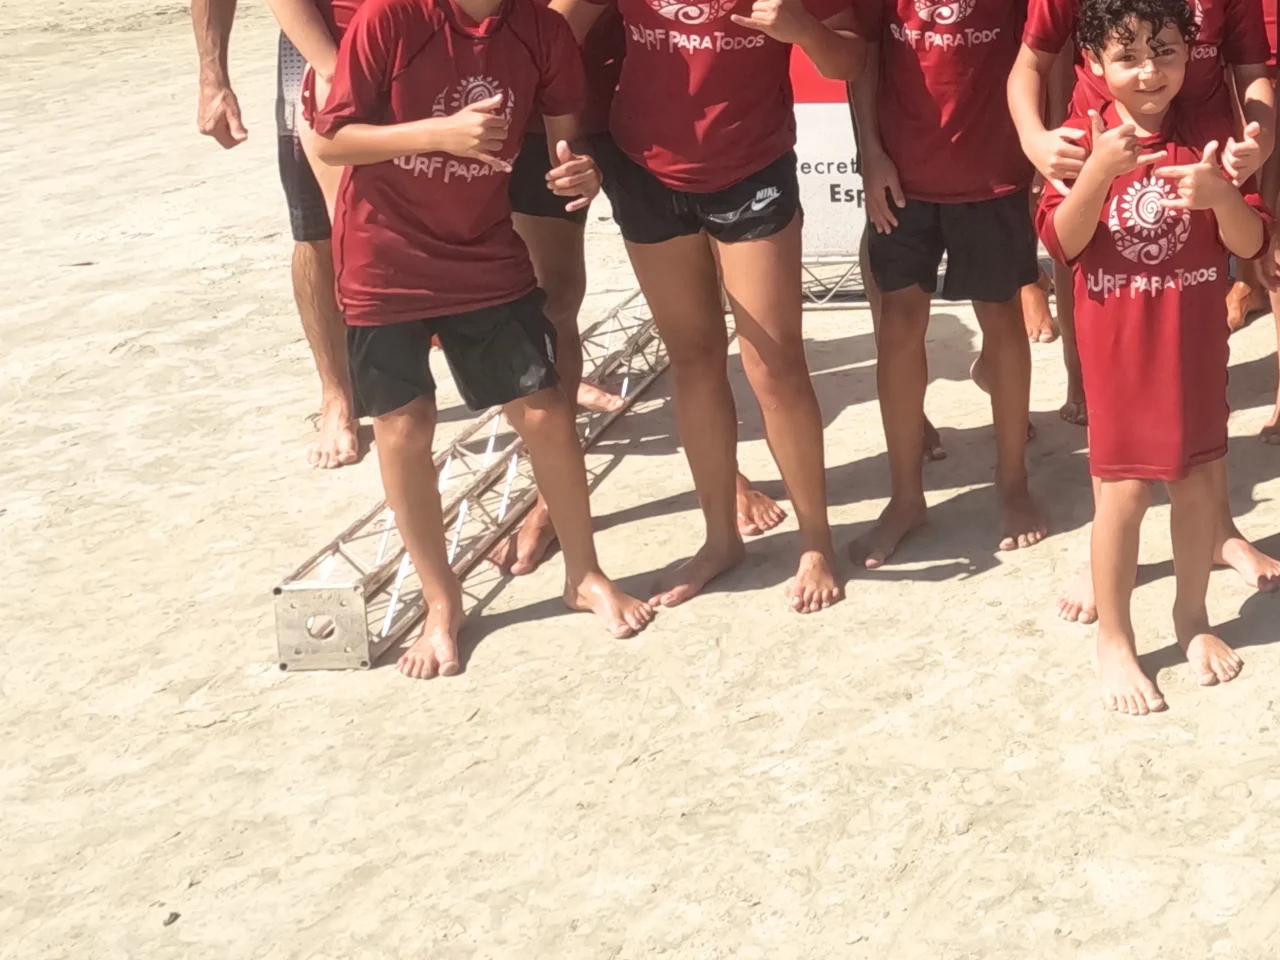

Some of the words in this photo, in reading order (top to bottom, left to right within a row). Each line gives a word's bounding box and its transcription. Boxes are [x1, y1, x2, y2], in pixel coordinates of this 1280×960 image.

[629, 23, 665, 51] SURF
[669, 30, 712, 54] PARA
[713, 31, 765, 53] TODOS
[924, 31, 965, 52] PARA
[964, 28, 1001, 48] TODO
[393, 154, 443, 179] URF
[443, 159, 490, 184] PARA
[800, 158, 857, 174] ecret
[756, 186, 778, 201] NIKE
[1130, 273, 1176, 299] PARA
[1174, 267, 1217, 291] TODOS
